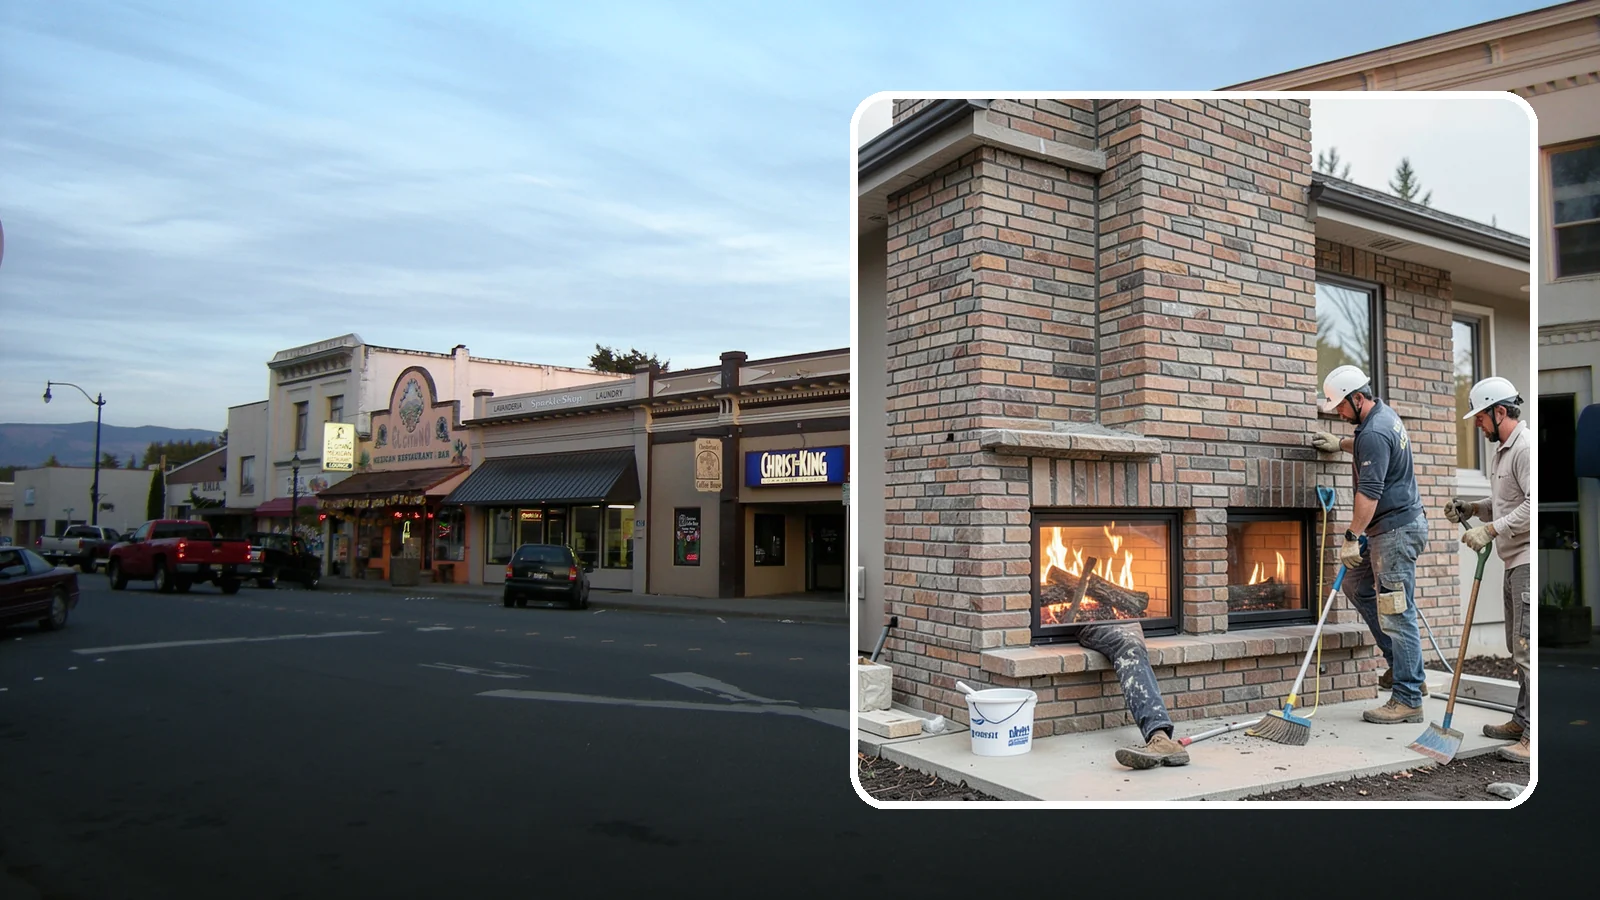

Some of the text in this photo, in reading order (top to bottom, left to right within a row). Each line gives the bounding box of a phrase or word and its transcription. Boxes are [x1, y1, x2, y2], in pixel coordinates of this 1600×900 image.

[531, 394, 582, 409] Sparkle Shop
[595, 389, 624, 400] LAUNDRY
[493, 402, 523, 412] LAVANDERIA
[374, 450, 450, 464] MEXICAN RESTAURANT BAR
[760, 450, 827, 478] CHRIST KING
